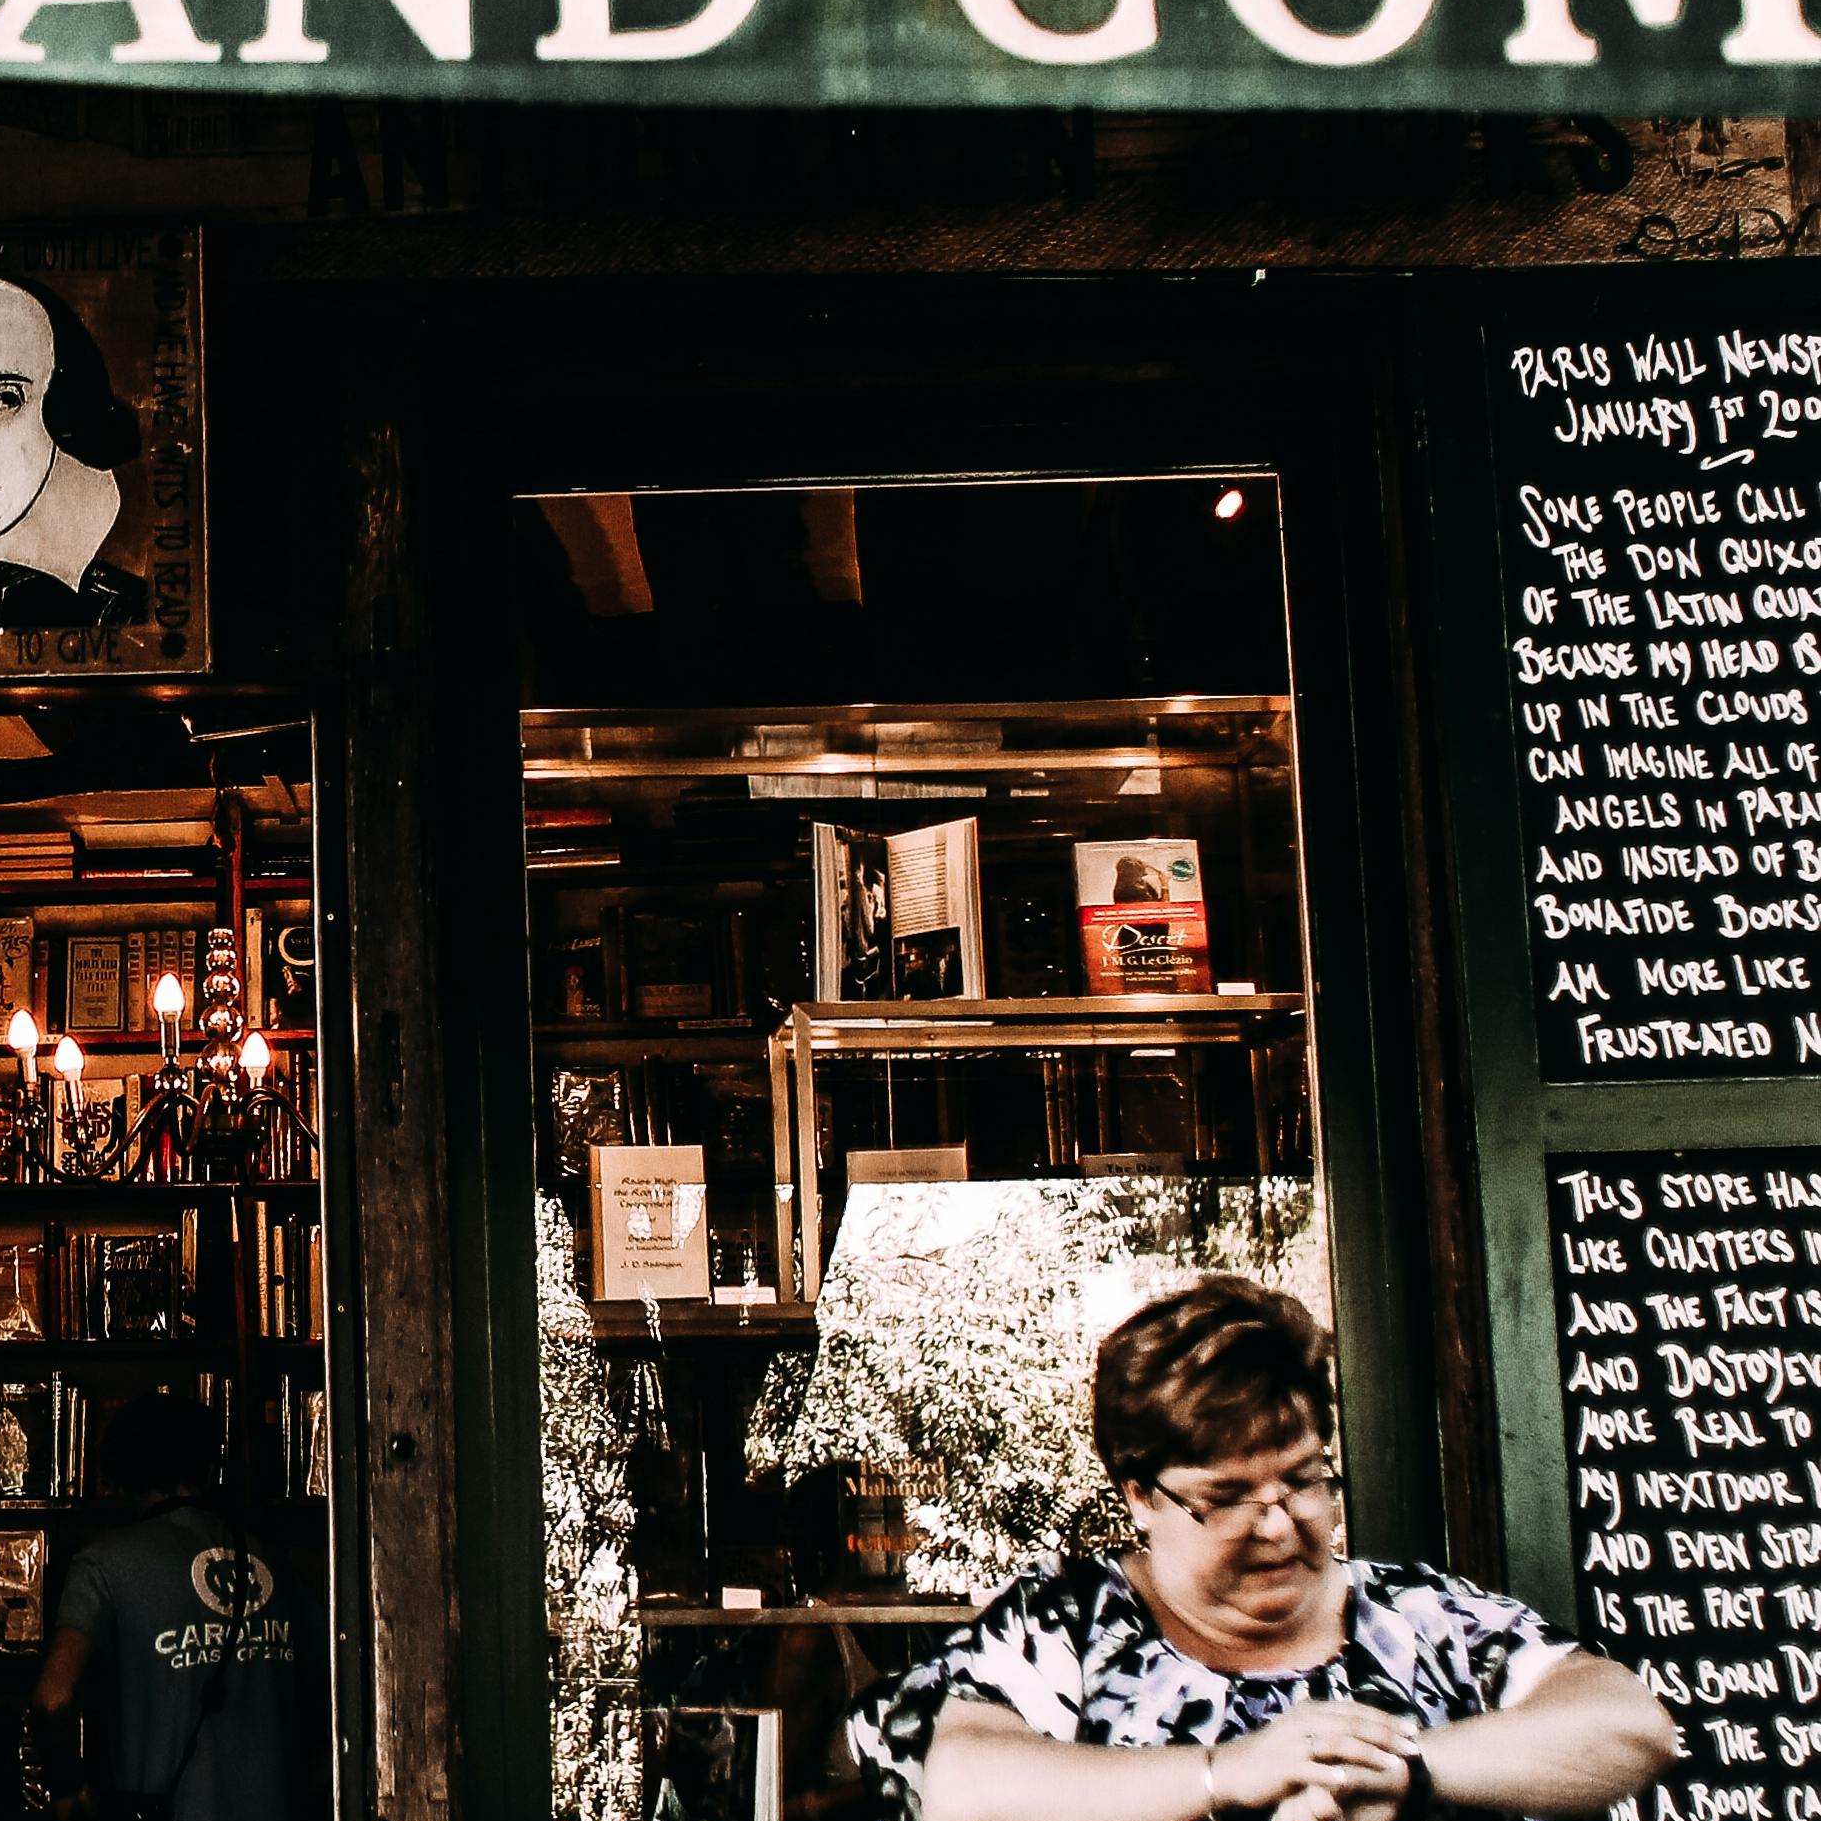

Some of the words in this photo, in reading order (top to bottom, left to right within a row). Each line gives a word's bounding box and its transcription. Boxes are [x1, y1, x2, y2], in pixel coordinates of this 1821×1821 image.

[91, 232, 151, 272] LIVE
[1511, 343, 1611, 397] PARIS
[1626, 334, 1706, 384] WALL
[1555, 397, 1696, 454] JANUARY
[155, 521, 191, 556] TO
[1520, 485, 1604, 548] SOME
[1613, 489, 1722, 535] PEOPLE
[1737, 483, 1806, 523] CALL
[1552, 542, 1607, 582] THE
[1627, 539, 1702, 581] DON
[155, 561, 191, 630] READ
[1522, 586, 1558, 626] OF
[1572, 588, 1635, 627] THE
[1645, 589, 1743, 630] LATIN
[16, 631, 43, 663] TO
[57, 628, 120, 663] GIVE
[1512, 636, 1638, 684] BECAUSE
[1649, 642, 1692, 686] MY
[1701, 640, 1779, 679] HEAD
[1523, 703, 1562, 743] UP
[1579, 694, 1611, 729] IN
[1620, 692, 1679, 729] THE
[1696, 690, 1809, 725] CLOUDS
[1527, 745, 1584, 783] CAN
[1604, 742, 1714, 781] IMAGINE
[1723, 743, 1779, 780] ALL
[1786, 743, 1820, 783] OF
[1555, 793, 1681, 835] ANGELS
[1695, 798, 1728, 834] IN
[1535, 846, 1603, 883] AND
[1622, 844, 1740, 884] INSTEAD
[1750, 842, 1785, 877] OF
[1102, 924, 1189, 952] Desert
[1534, 893, 1695, 940] BONAFIDE
[1548, 961, 1611, 1004] AM
[1636, 957, 1727, 996] MORE
[1732, 954, 1811, 996] LIKE
[1576, 1013, 1773, 1064] FRUSTRATED
[1557, 1170, 1644, 1223] THIS
[1659, 1172, 1758, 1212] STORE
[1562, 1233, 1628, 1275] LIKE
[1643, 1227, 1796, 1273] CHAPTERS
[1567, 1292, 1637, 1338] AND
[1645, 1292, 1707, 1331] THE
[1714, 1284, 1787, 1332] FACT
[1567, 1352, 1639, 1396] AND
[1578, 1406, 1656, 1456] MORE
[1674, 1406, 1766, 1458] REAL
[1769, 1406, 1812, 1448] TO
[1580, 1467, 1622, 1531] MY
[1636, 1471, 1718, 1513] NEXT
[1718, 1472, 1803, 1514] DOOR
[1583, 1530, 1652, 1576] AND
[1664, 1530, 1753, 1574] EVEN
[1592, 1586, 1627, 1636] IS
[1633, 1593, 1695, 1638] THE
[1702, 1584, 1765, 1631] FACT
[1695, 1659, 1780, 1705] BORN
[1704, 1717, 1767, 1766] THE
